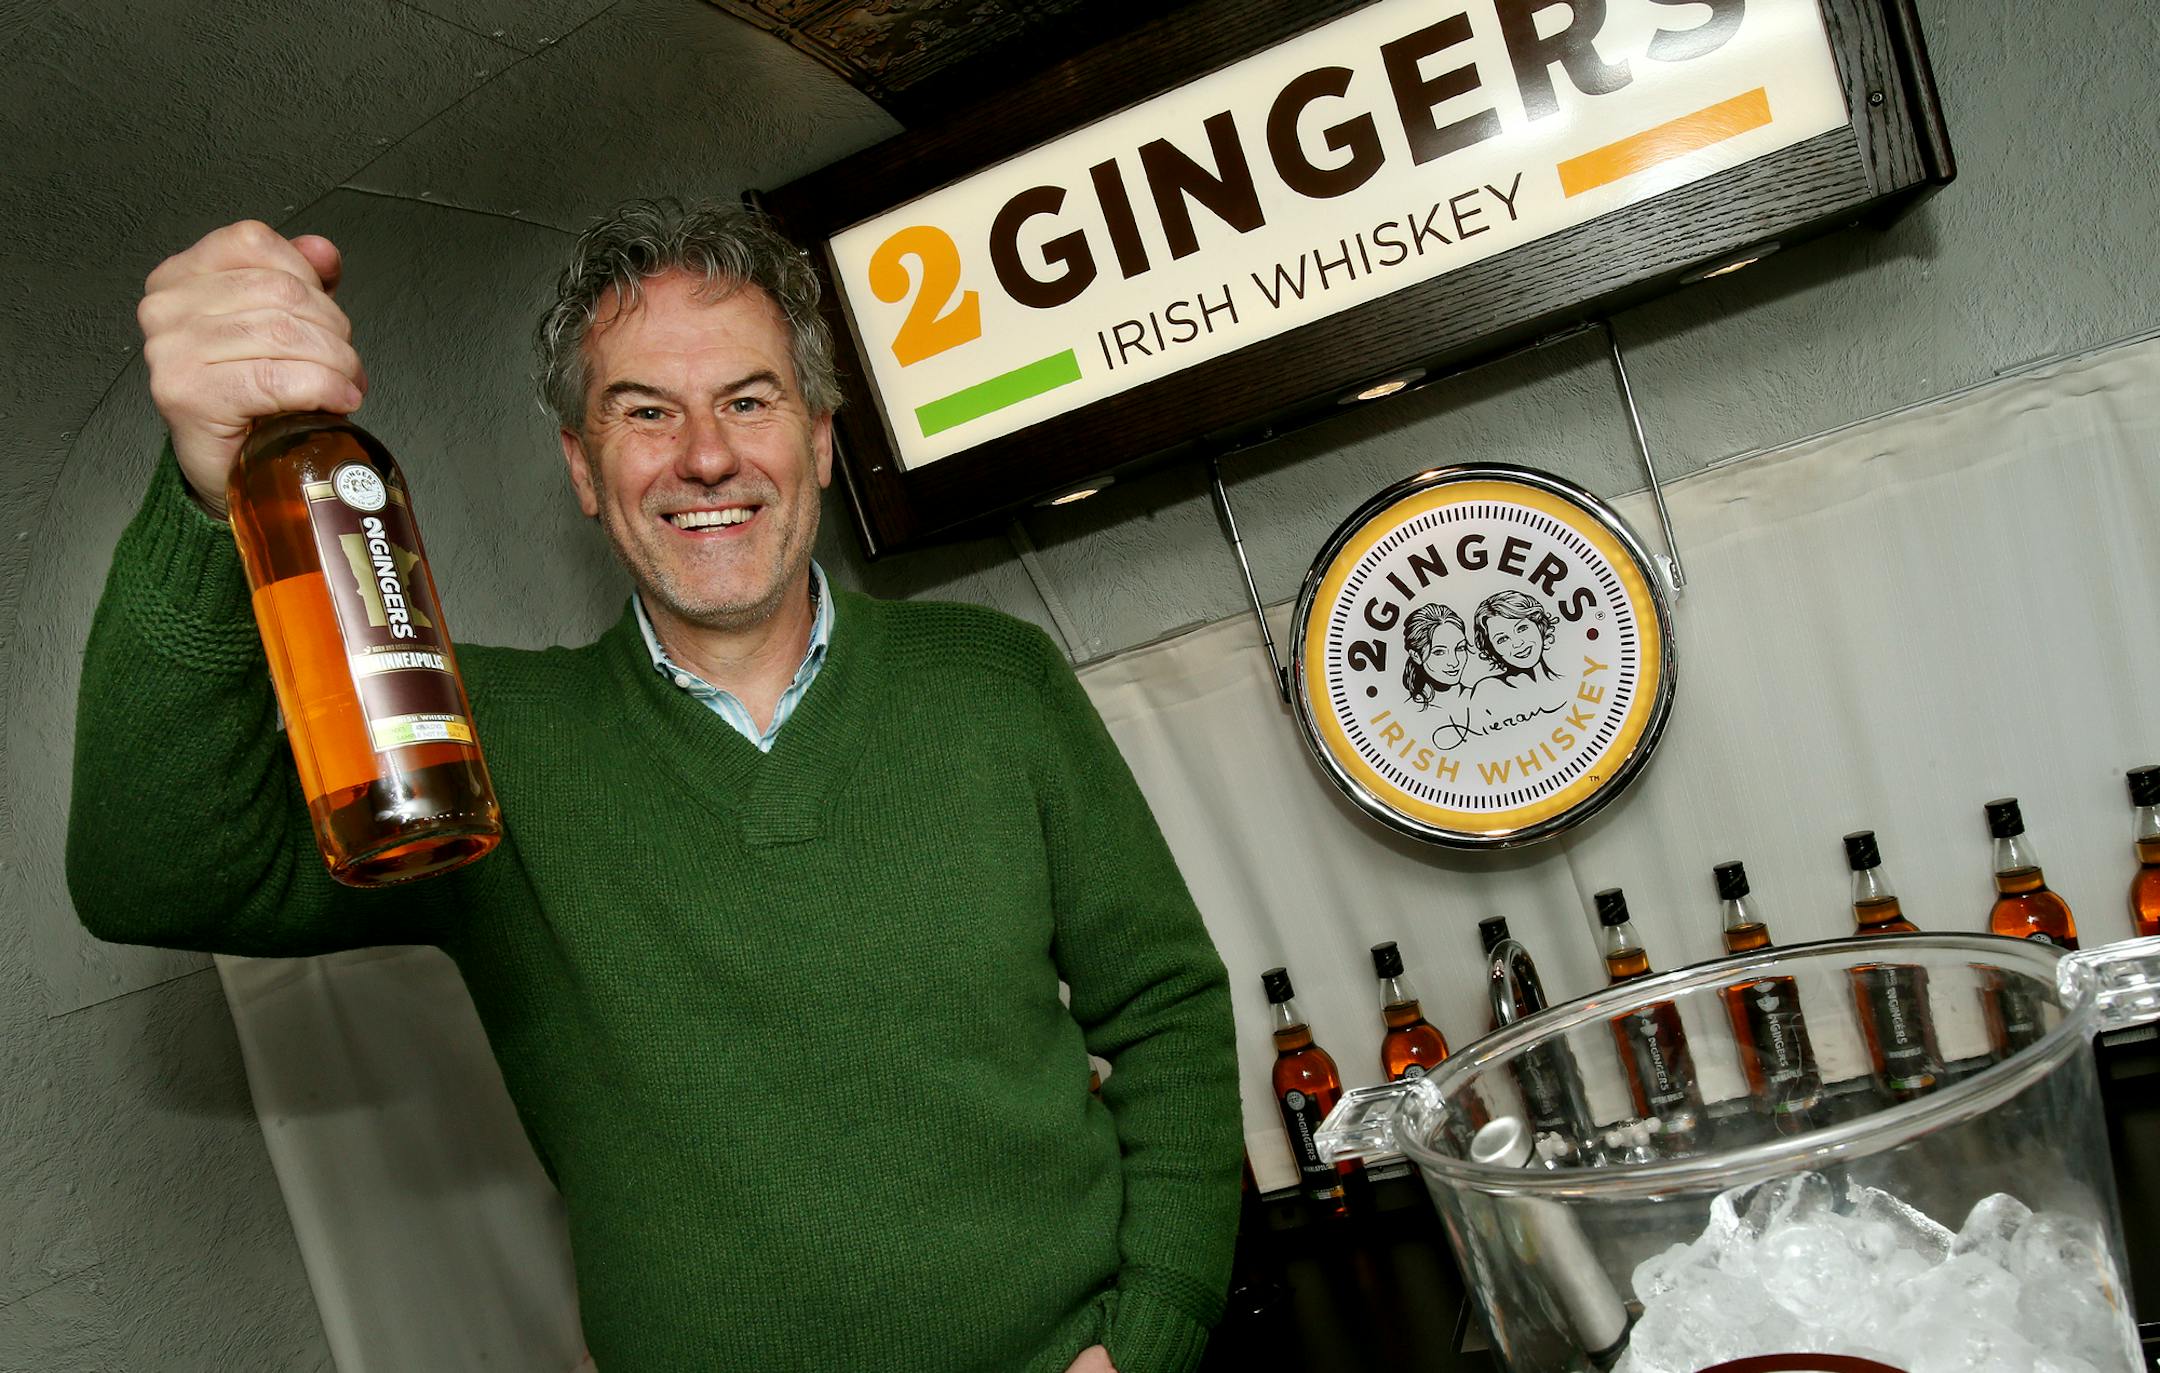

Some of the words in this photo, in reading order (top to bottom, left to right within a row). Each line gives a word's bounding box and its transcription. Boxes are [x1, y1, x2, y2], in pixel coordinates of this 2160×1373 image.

[1097, 283, 1239, 370] IRISH
[1250, 172, 1522, 309] WHISKEY
[363, 516, 414, 640] 2GINGERS
[1369, 710, 1461, 784] IRISH
[1477, 655, 1609, 787] WHISKEY
[1431, 700, 1568, 752] Kieran
